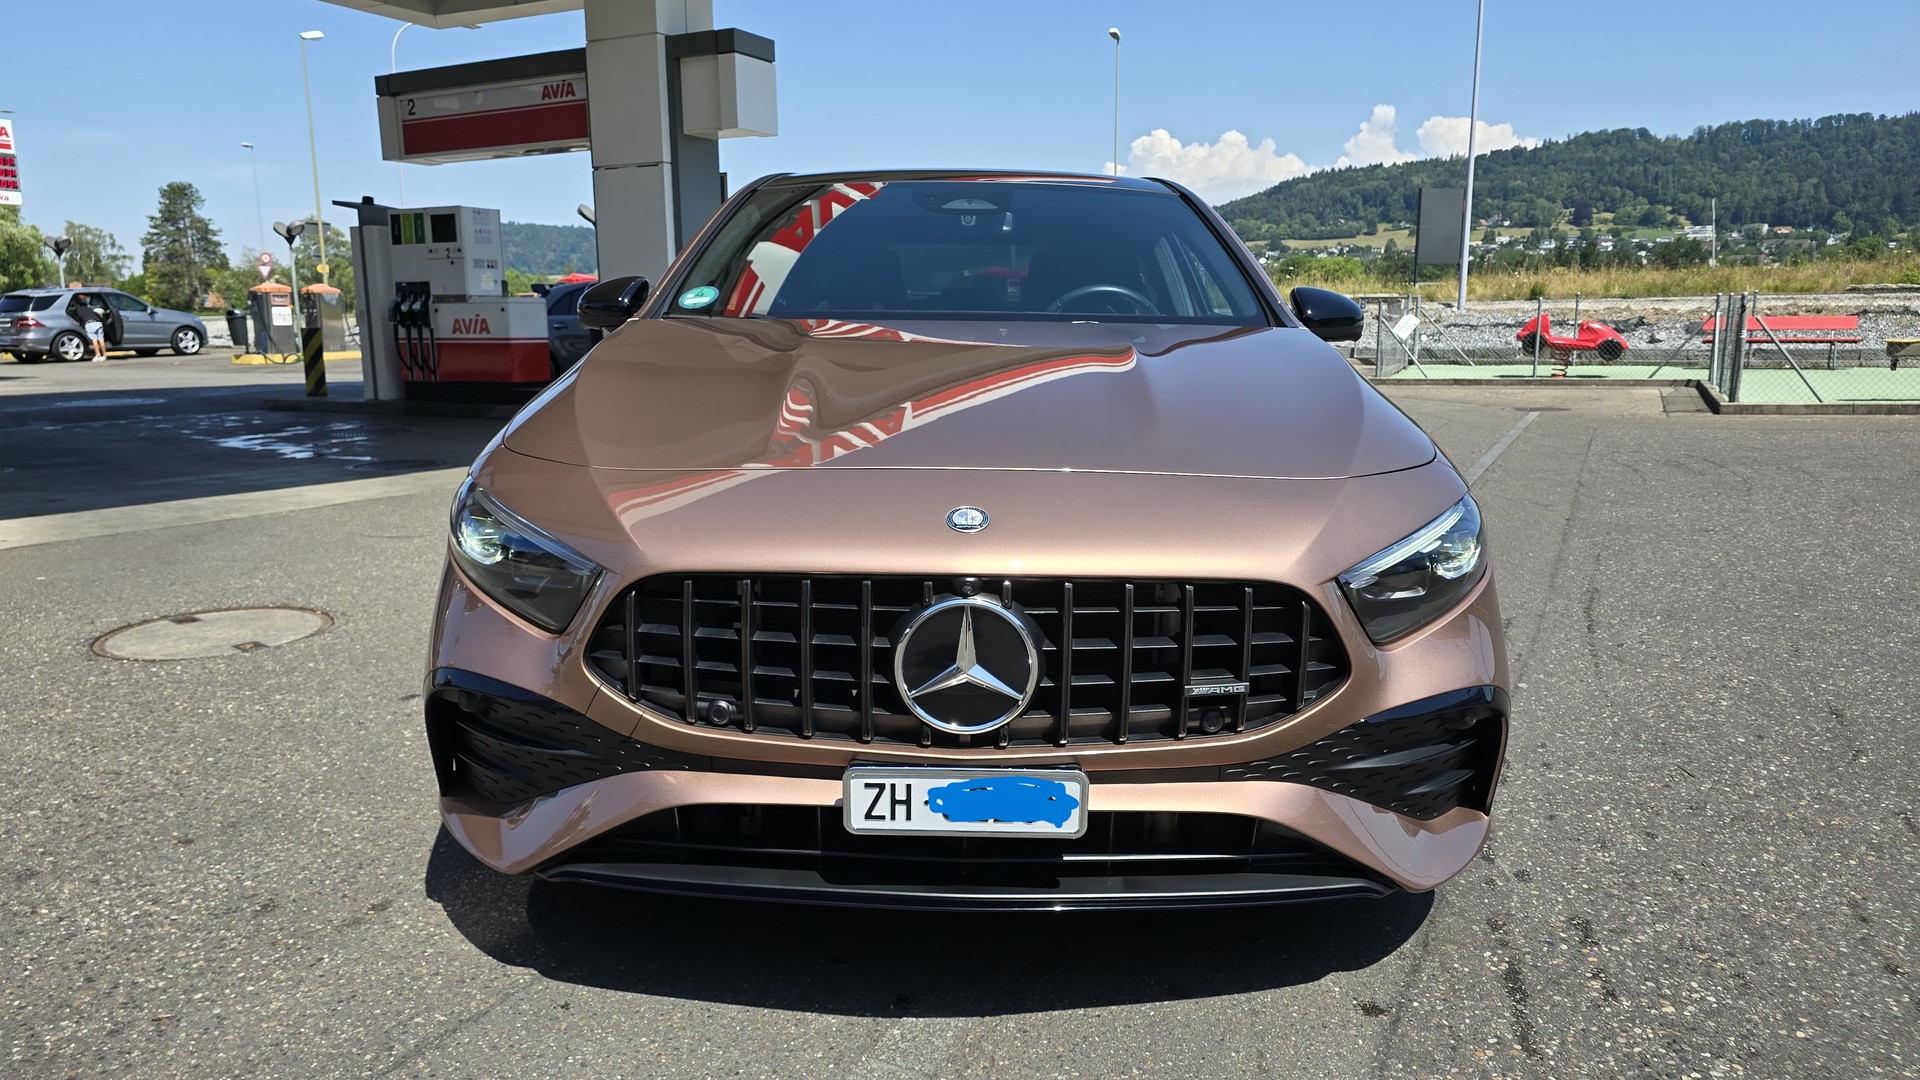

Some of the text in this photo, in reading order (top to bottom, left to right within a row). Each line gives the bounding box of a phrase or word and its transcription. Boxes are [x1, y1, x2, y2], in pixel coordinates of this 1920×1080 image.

[407, 98, 416, 116] 2
[445, 247, 451, 259] 2
[863, 782, 912, 822] ZH
